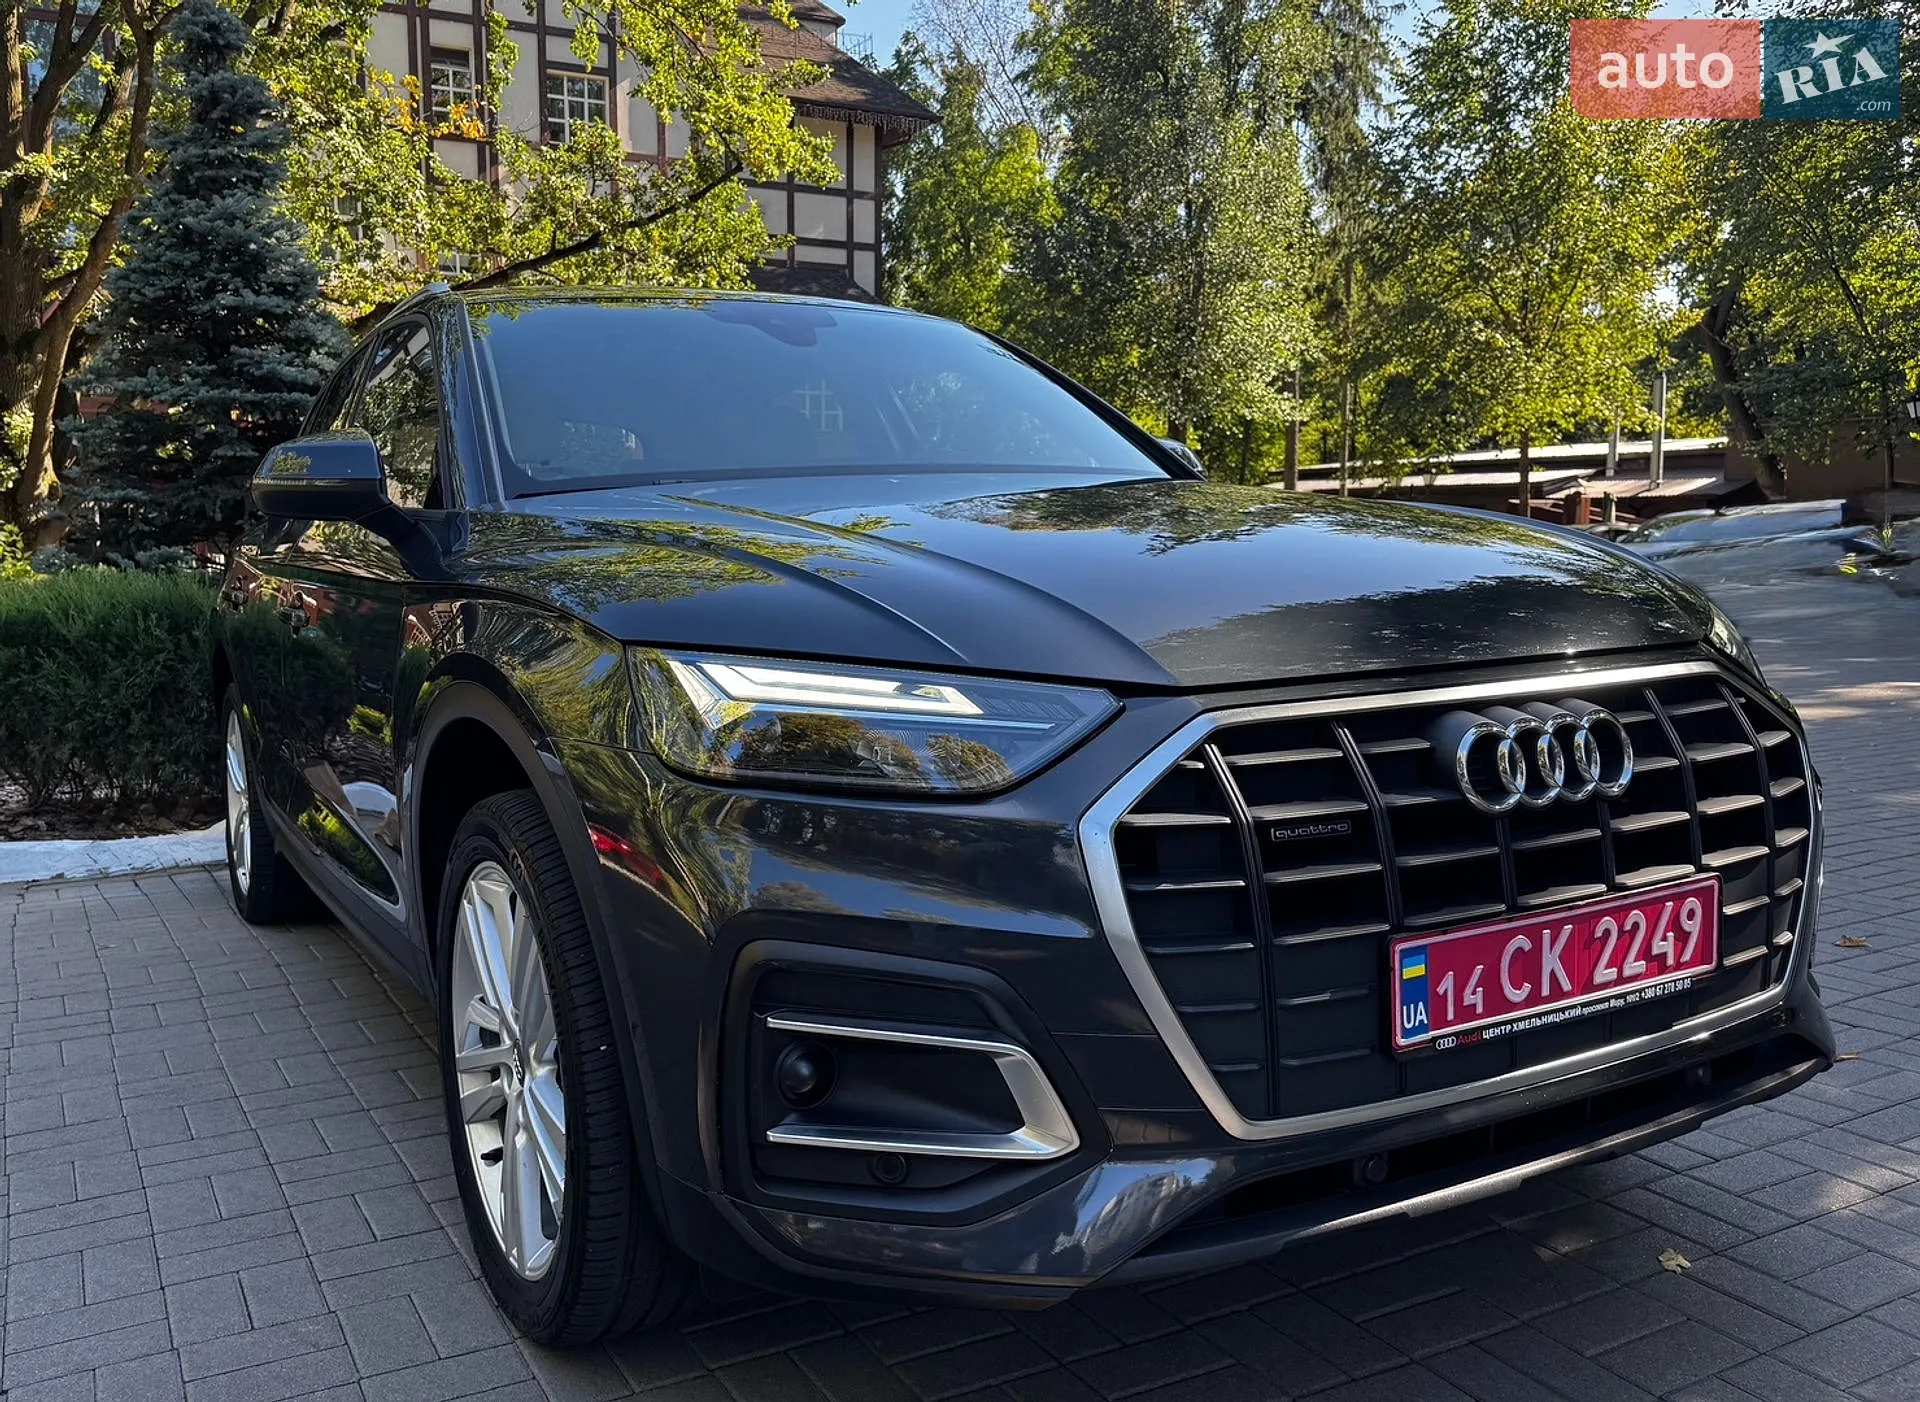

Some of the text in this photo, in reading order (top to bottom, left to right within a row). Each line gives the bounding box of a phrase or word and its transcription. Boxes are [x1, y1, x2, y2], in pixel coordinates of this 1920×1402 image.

[1275, 823, 1348, 840] quattro
[1436, 965, 1485, 1021] 14
[1592, 896, 1702, 986] 2249
[1402, 1001, 1428, 1029] UA
[1457, 1031, 1481, 1045] Audi
[1482, 1024, 1512, 1039] ЦЕНТР
[1512, 1006, 1581, 1032] ХМЕЛЬНИЦЬКИЙ
